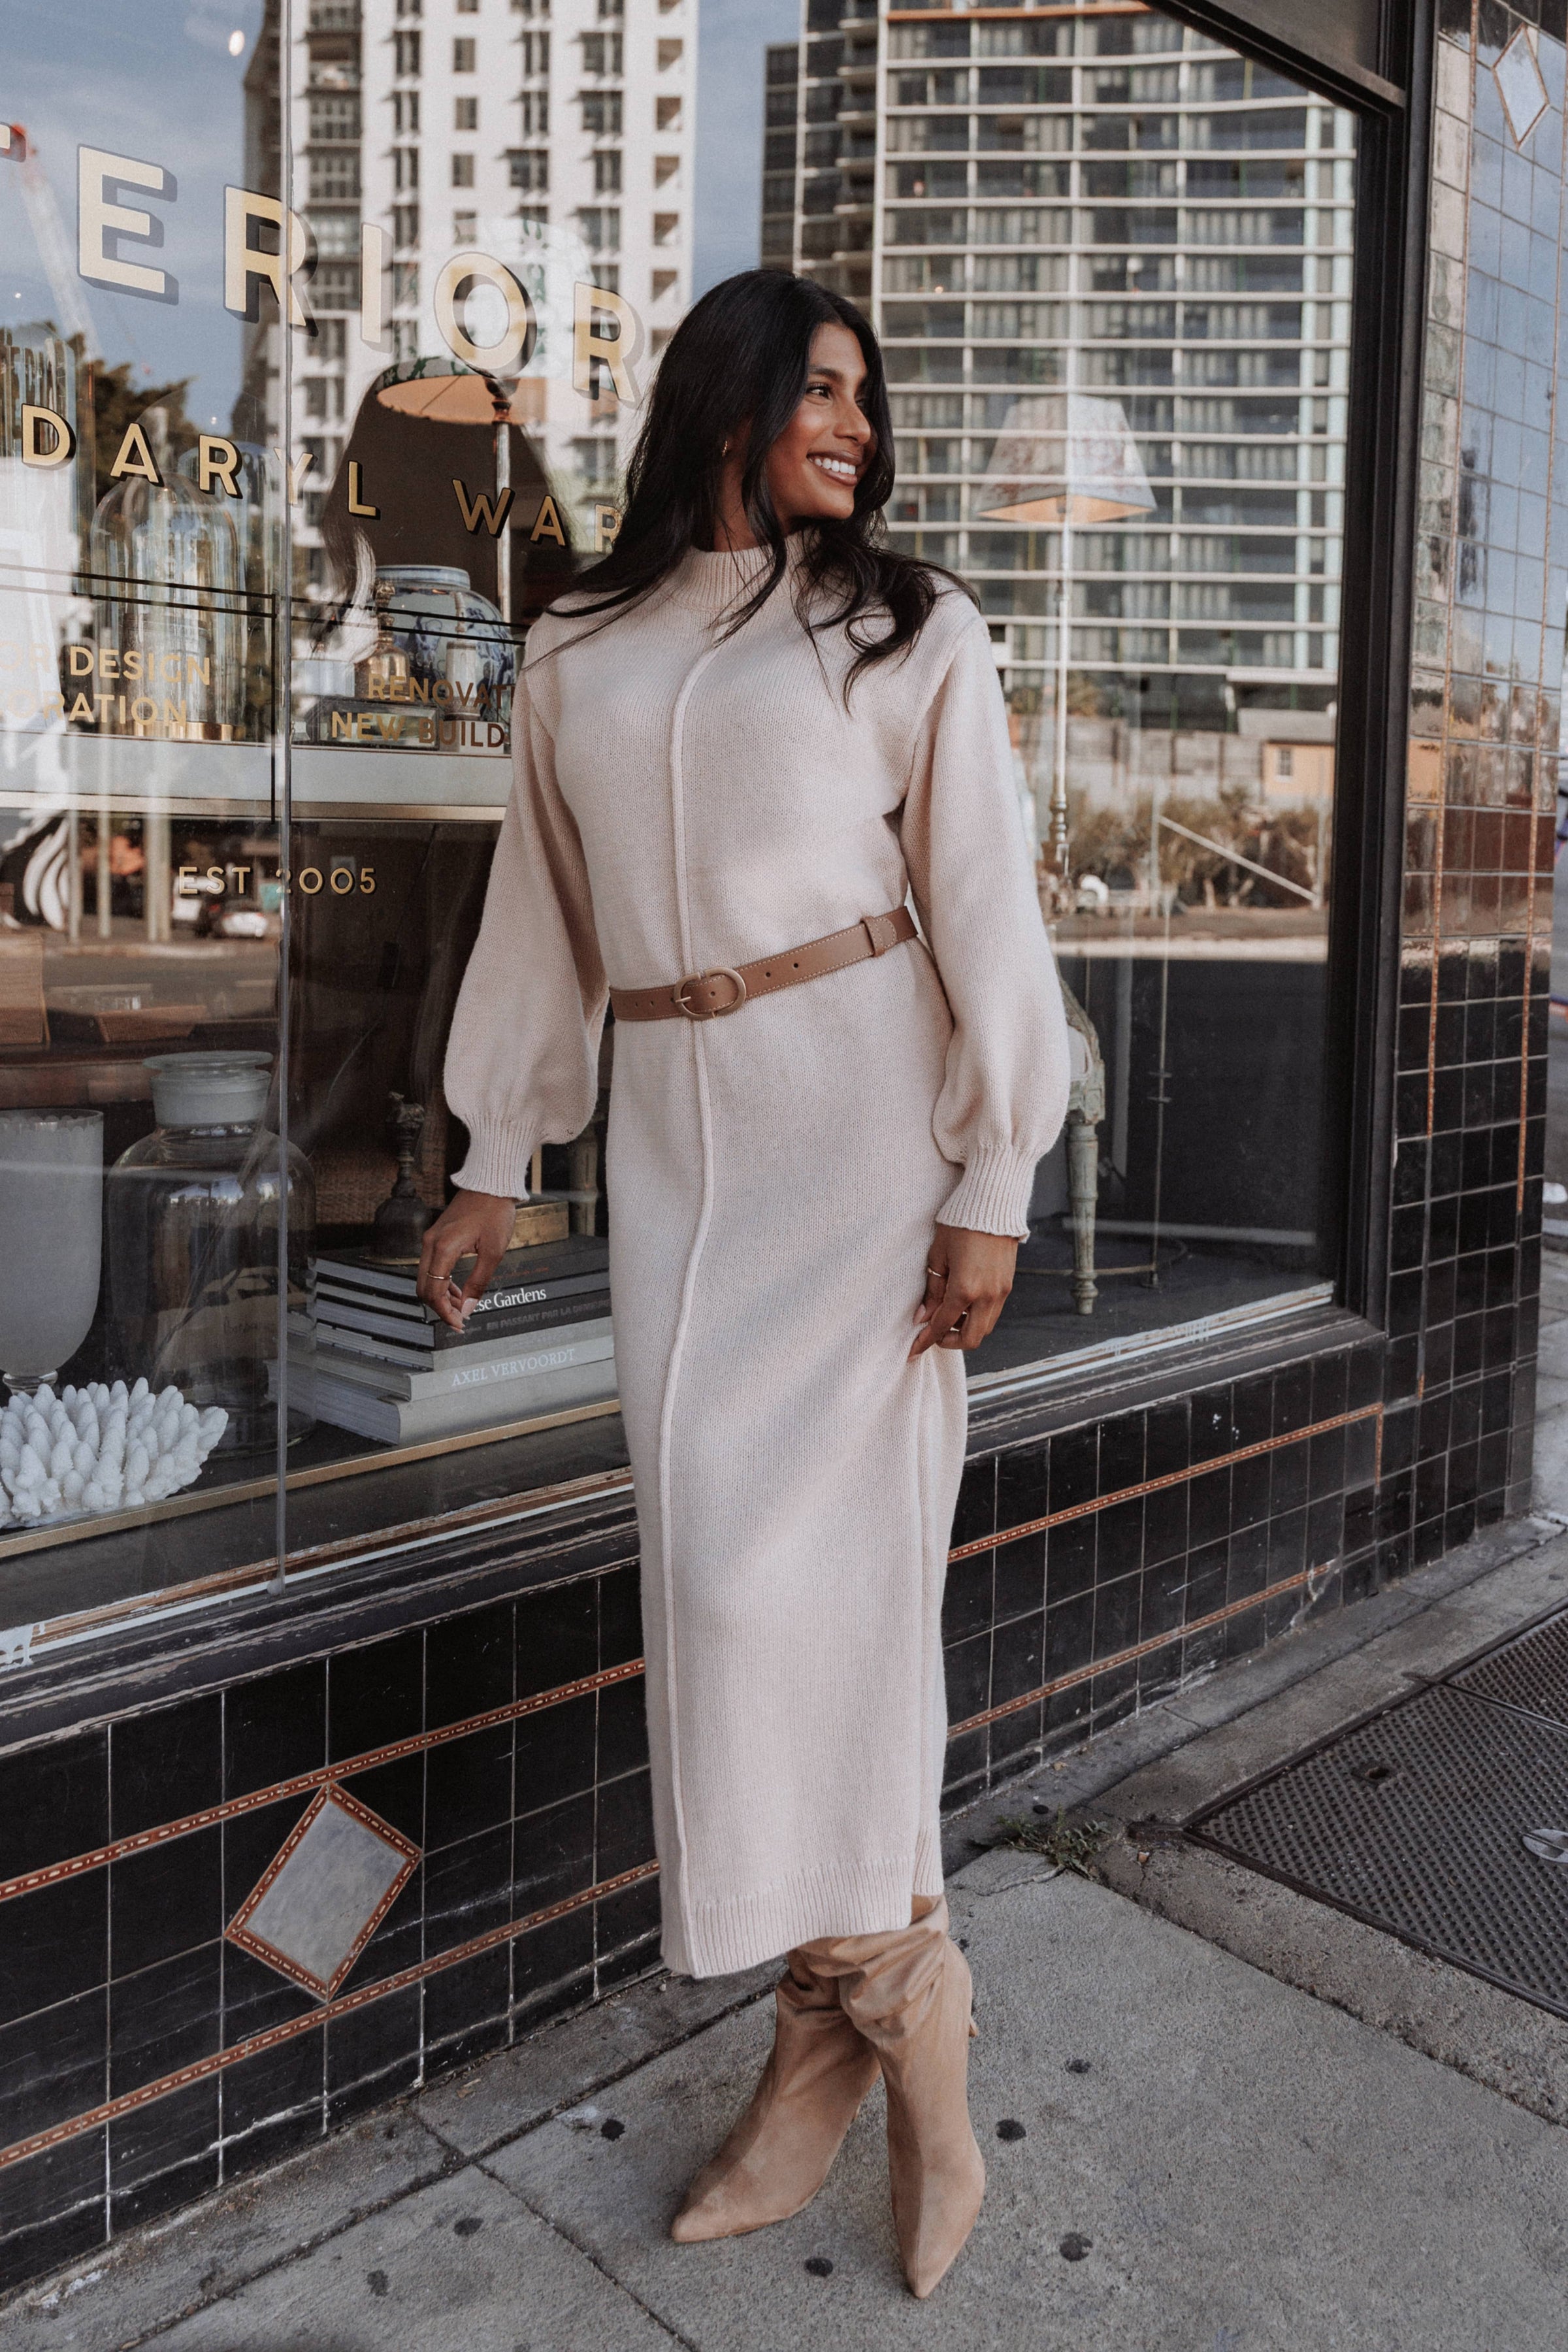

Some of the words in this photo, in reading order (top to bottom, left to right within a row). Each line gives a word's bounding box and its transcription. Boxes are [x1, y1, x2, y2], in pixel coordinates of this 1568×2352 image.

[0, 123, 643, 408] ERIOR
[22, 403, 379, 520] DARYL
[70, 645, 210, 685] DESIGN
[0, 689, 187, 727] ORATION
[332, 711, 406, 742] NEW
[419, 719, 505, 748] BUILD
[178, 866, 251, 894] EST
[275, 867, 376, 895] 2005
[493, 1288, 547, 1308] Gardens
[451, 1366, 488, 1386] AXEL
[491, 1348, 575, 1381] VERVOORDT
